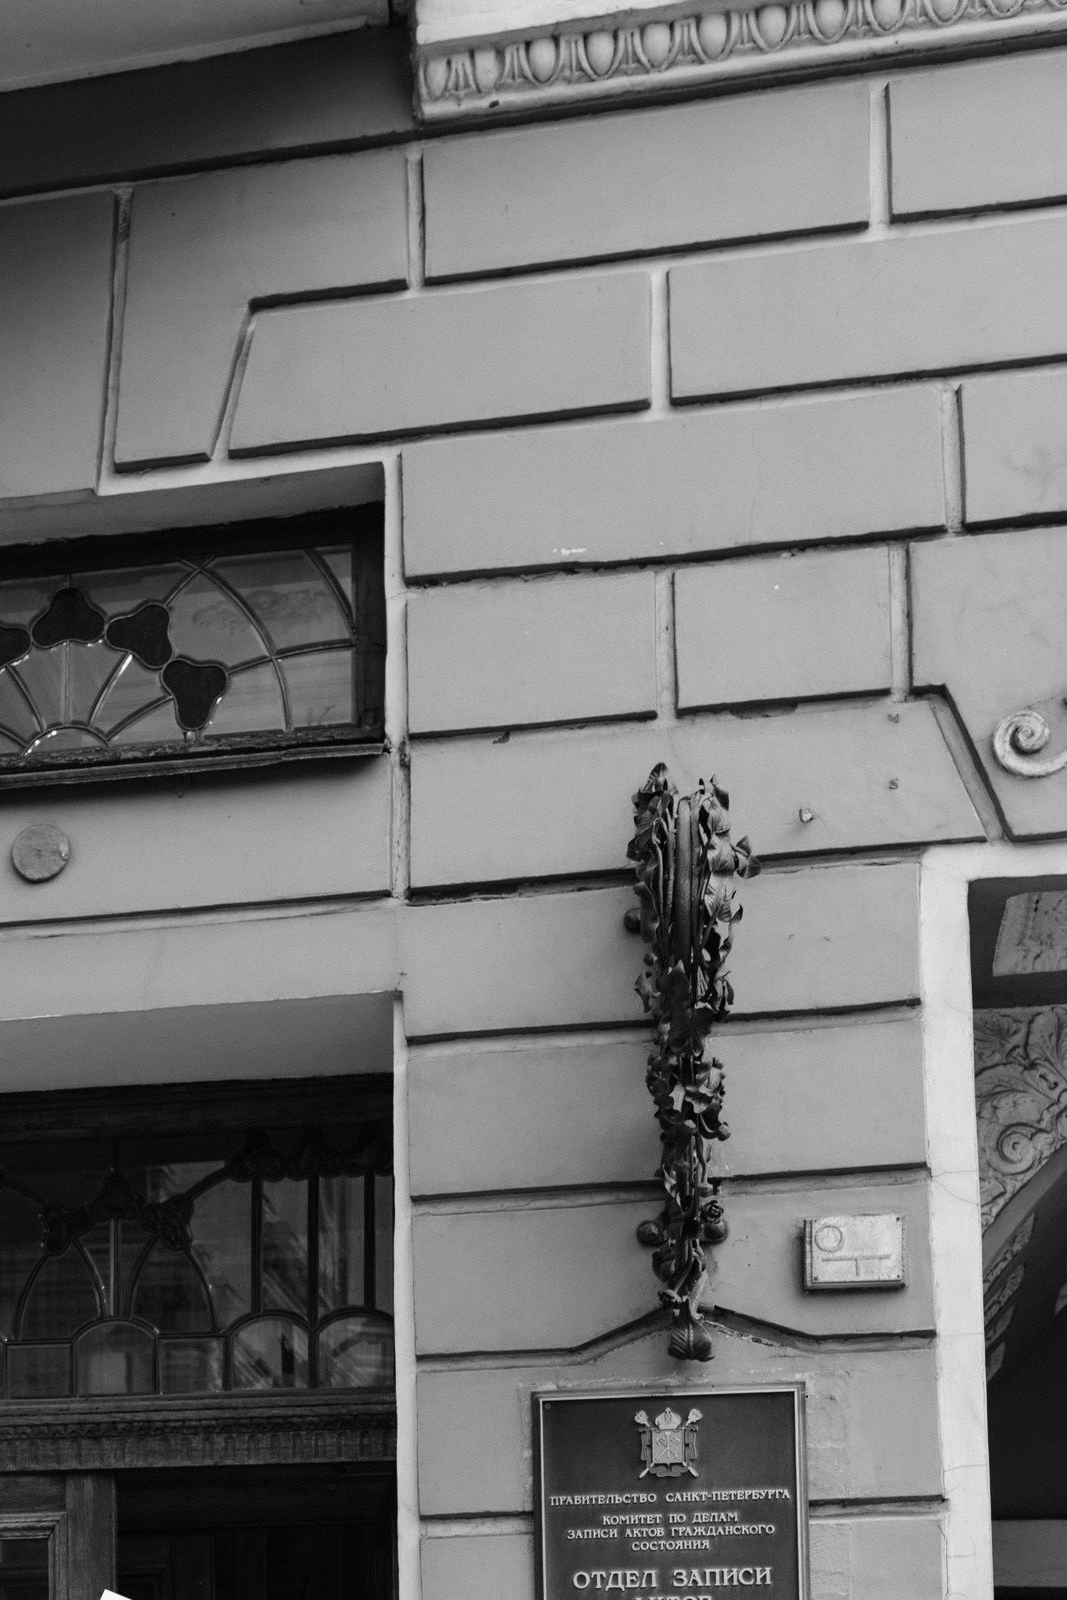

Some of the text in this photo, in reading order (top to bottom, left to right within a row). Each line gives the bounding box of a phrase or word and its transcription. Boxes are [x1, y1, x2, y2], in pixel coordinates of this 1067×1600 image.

[551, 1489, 790, 1506] ПРАВИТЕЛЬСТВО САНКТ-ПЕТЕРБУРГА
[602, 1512, 738, 1525] КОМИТЕТ ПО ДЕЛАМ
[567, 1524, 775, 1540] ЗАПИСИ АКТОВ ГРАЖДАНСКОГО
[632, 1539, 710, 1551] СОСТОЯНИЯ
[572, 1567, 772, 1591] ОТДЕЛ ЗАПИСИ
